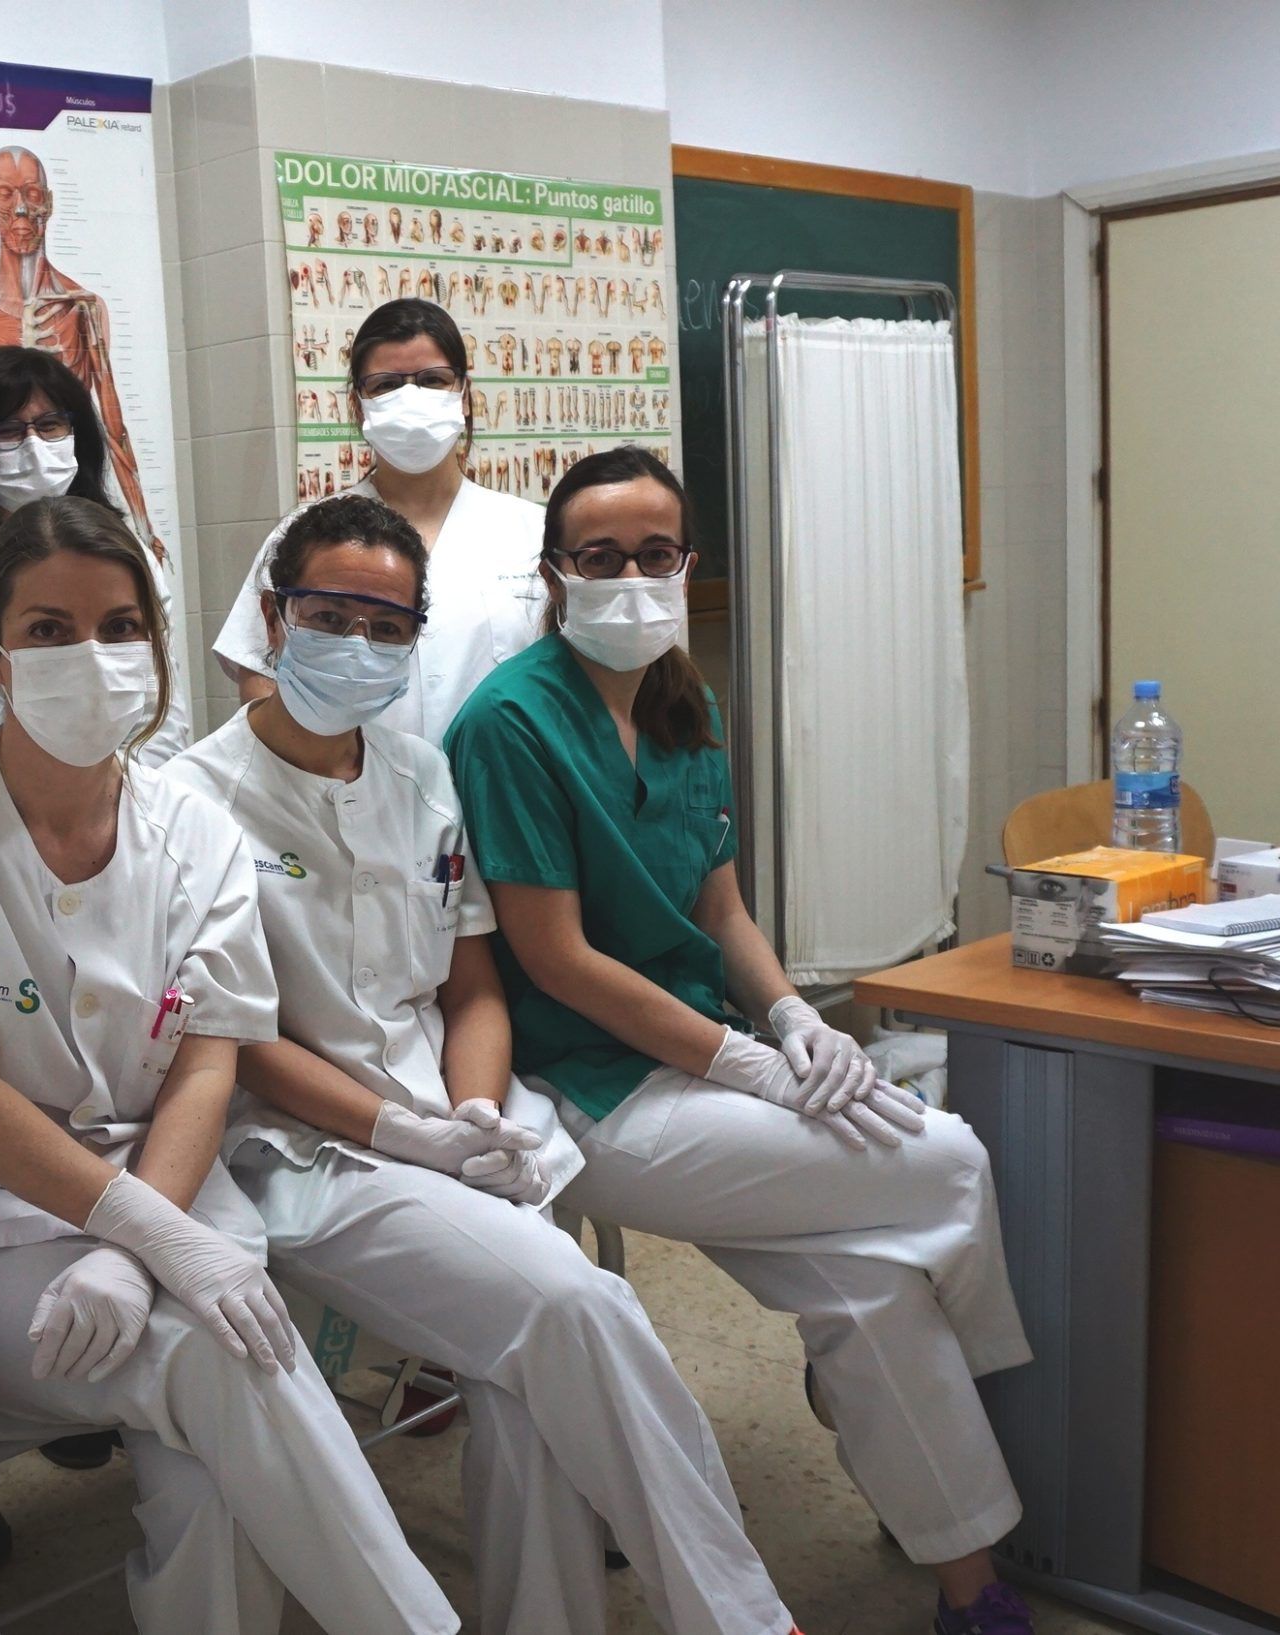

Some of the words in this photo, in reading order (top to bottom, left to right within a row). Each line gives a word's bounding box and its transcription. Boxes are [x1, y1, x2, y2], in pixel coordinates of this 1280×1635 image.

[284, 158, 378, 190] DOLOR
[383, 166, 530, 204] MIOFASCIAL:
[534, 182, 599, 210] Puntos
[602, 194, 656, 217] gatillo
